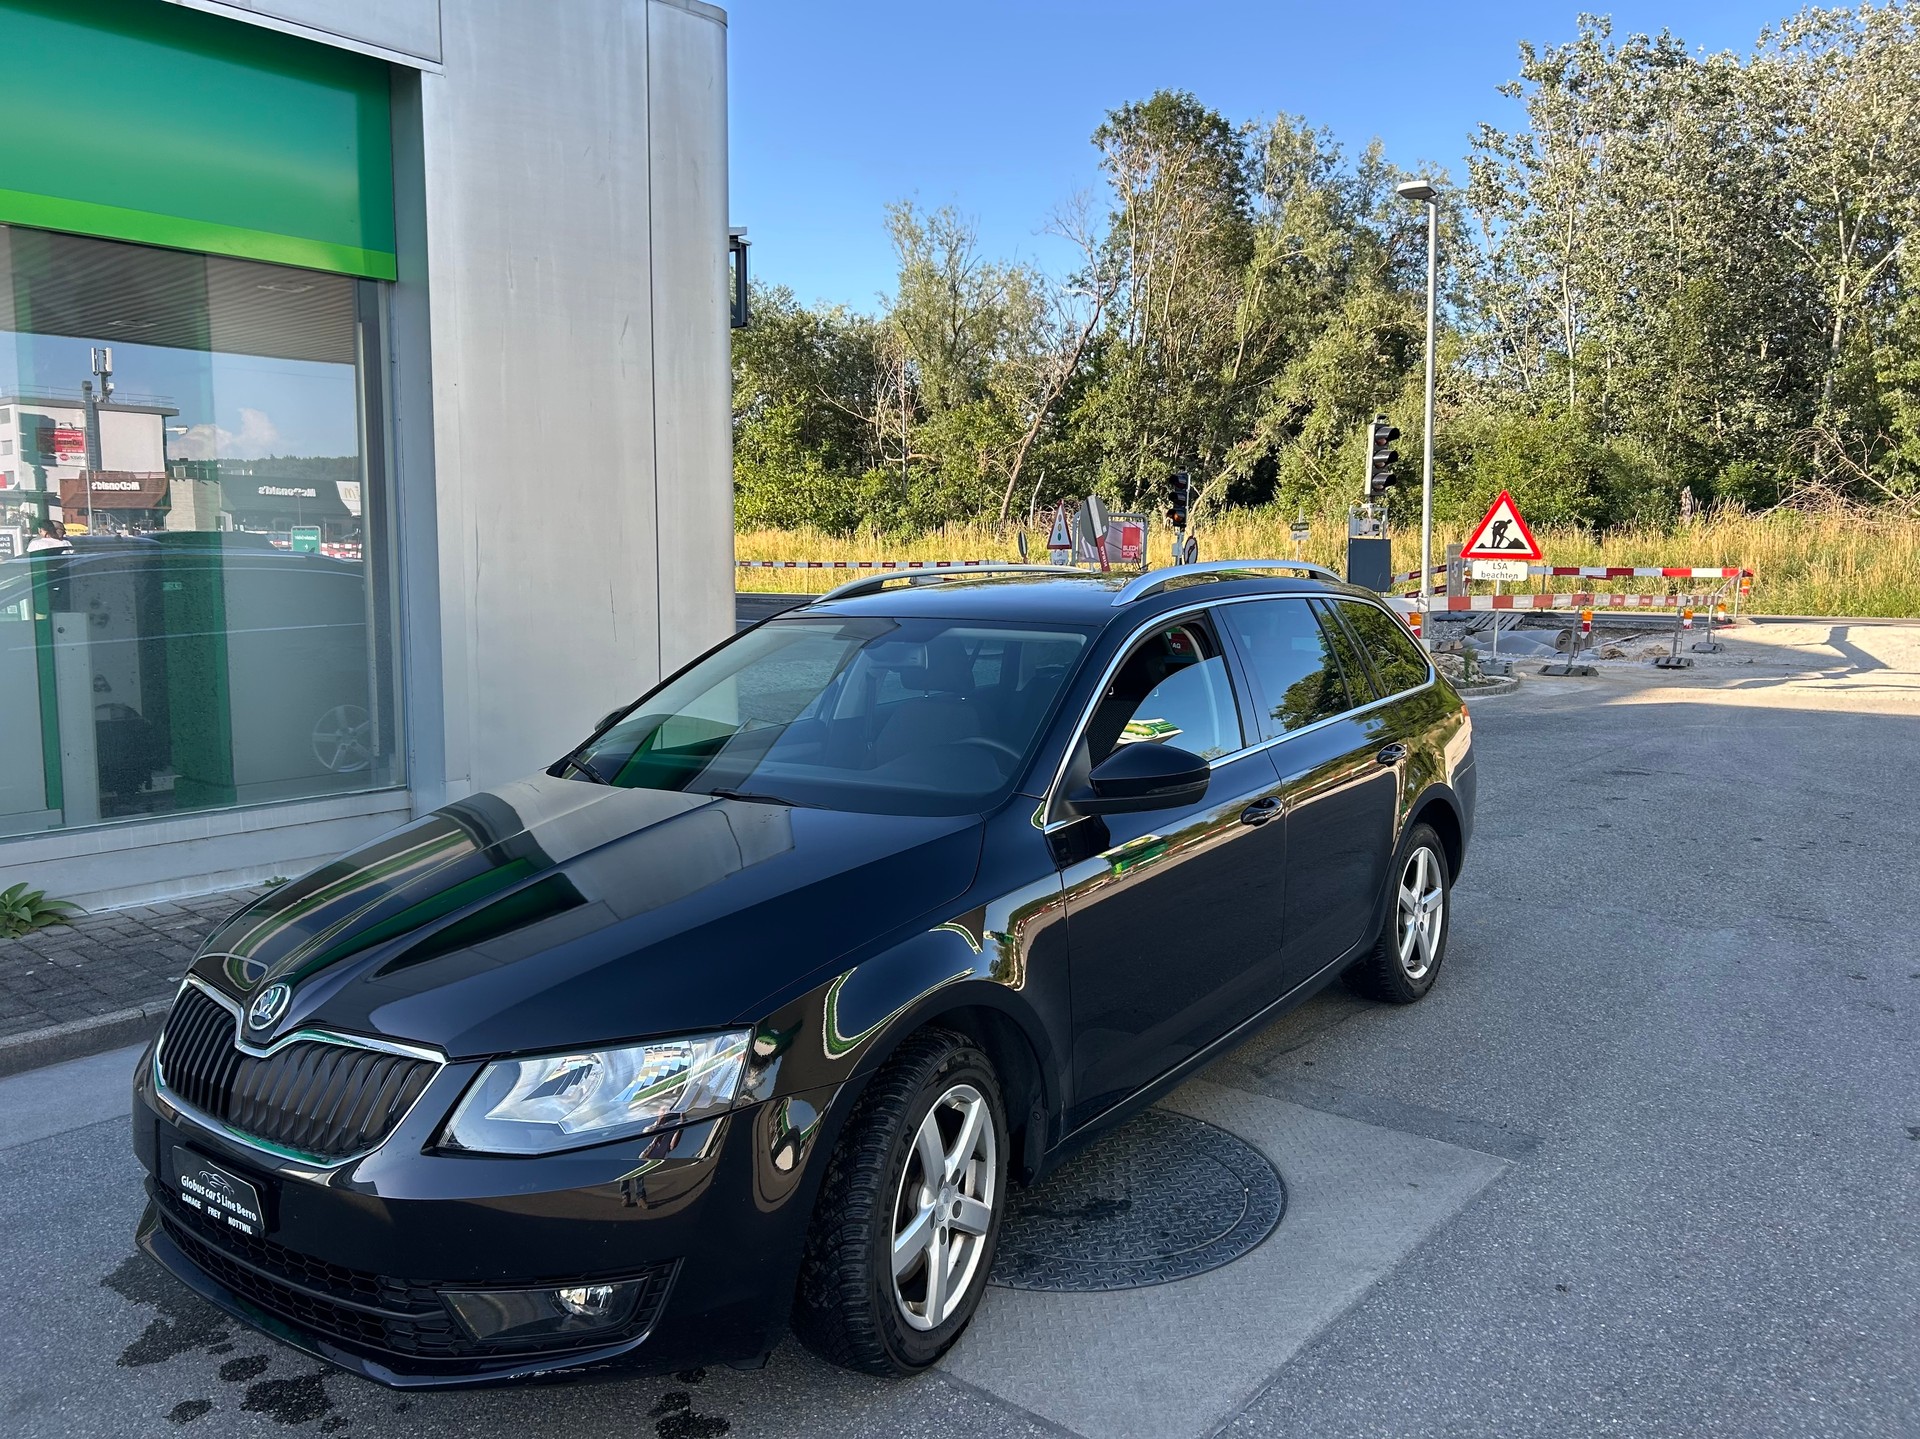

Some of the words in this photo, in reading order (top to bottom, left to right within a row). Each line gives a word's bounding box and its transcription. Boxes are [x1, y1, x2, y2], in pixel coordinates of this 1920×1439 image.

[1481, 571, 1519, 579] beachten
[1492, 562, 1508, 570] LSA
[181, 1175, 205, 1196] Globus
[221, 1194, 236, 1212] Line
[236, 1202, 257, 1222] Berro
[880, 1124, 914, 1237] NEXEN
[181, 1192, 202, 1210] GARAGE
[207, 1206, 221, 1220] FREY
[228, 1216, 253, 1235] NOTTWIL
